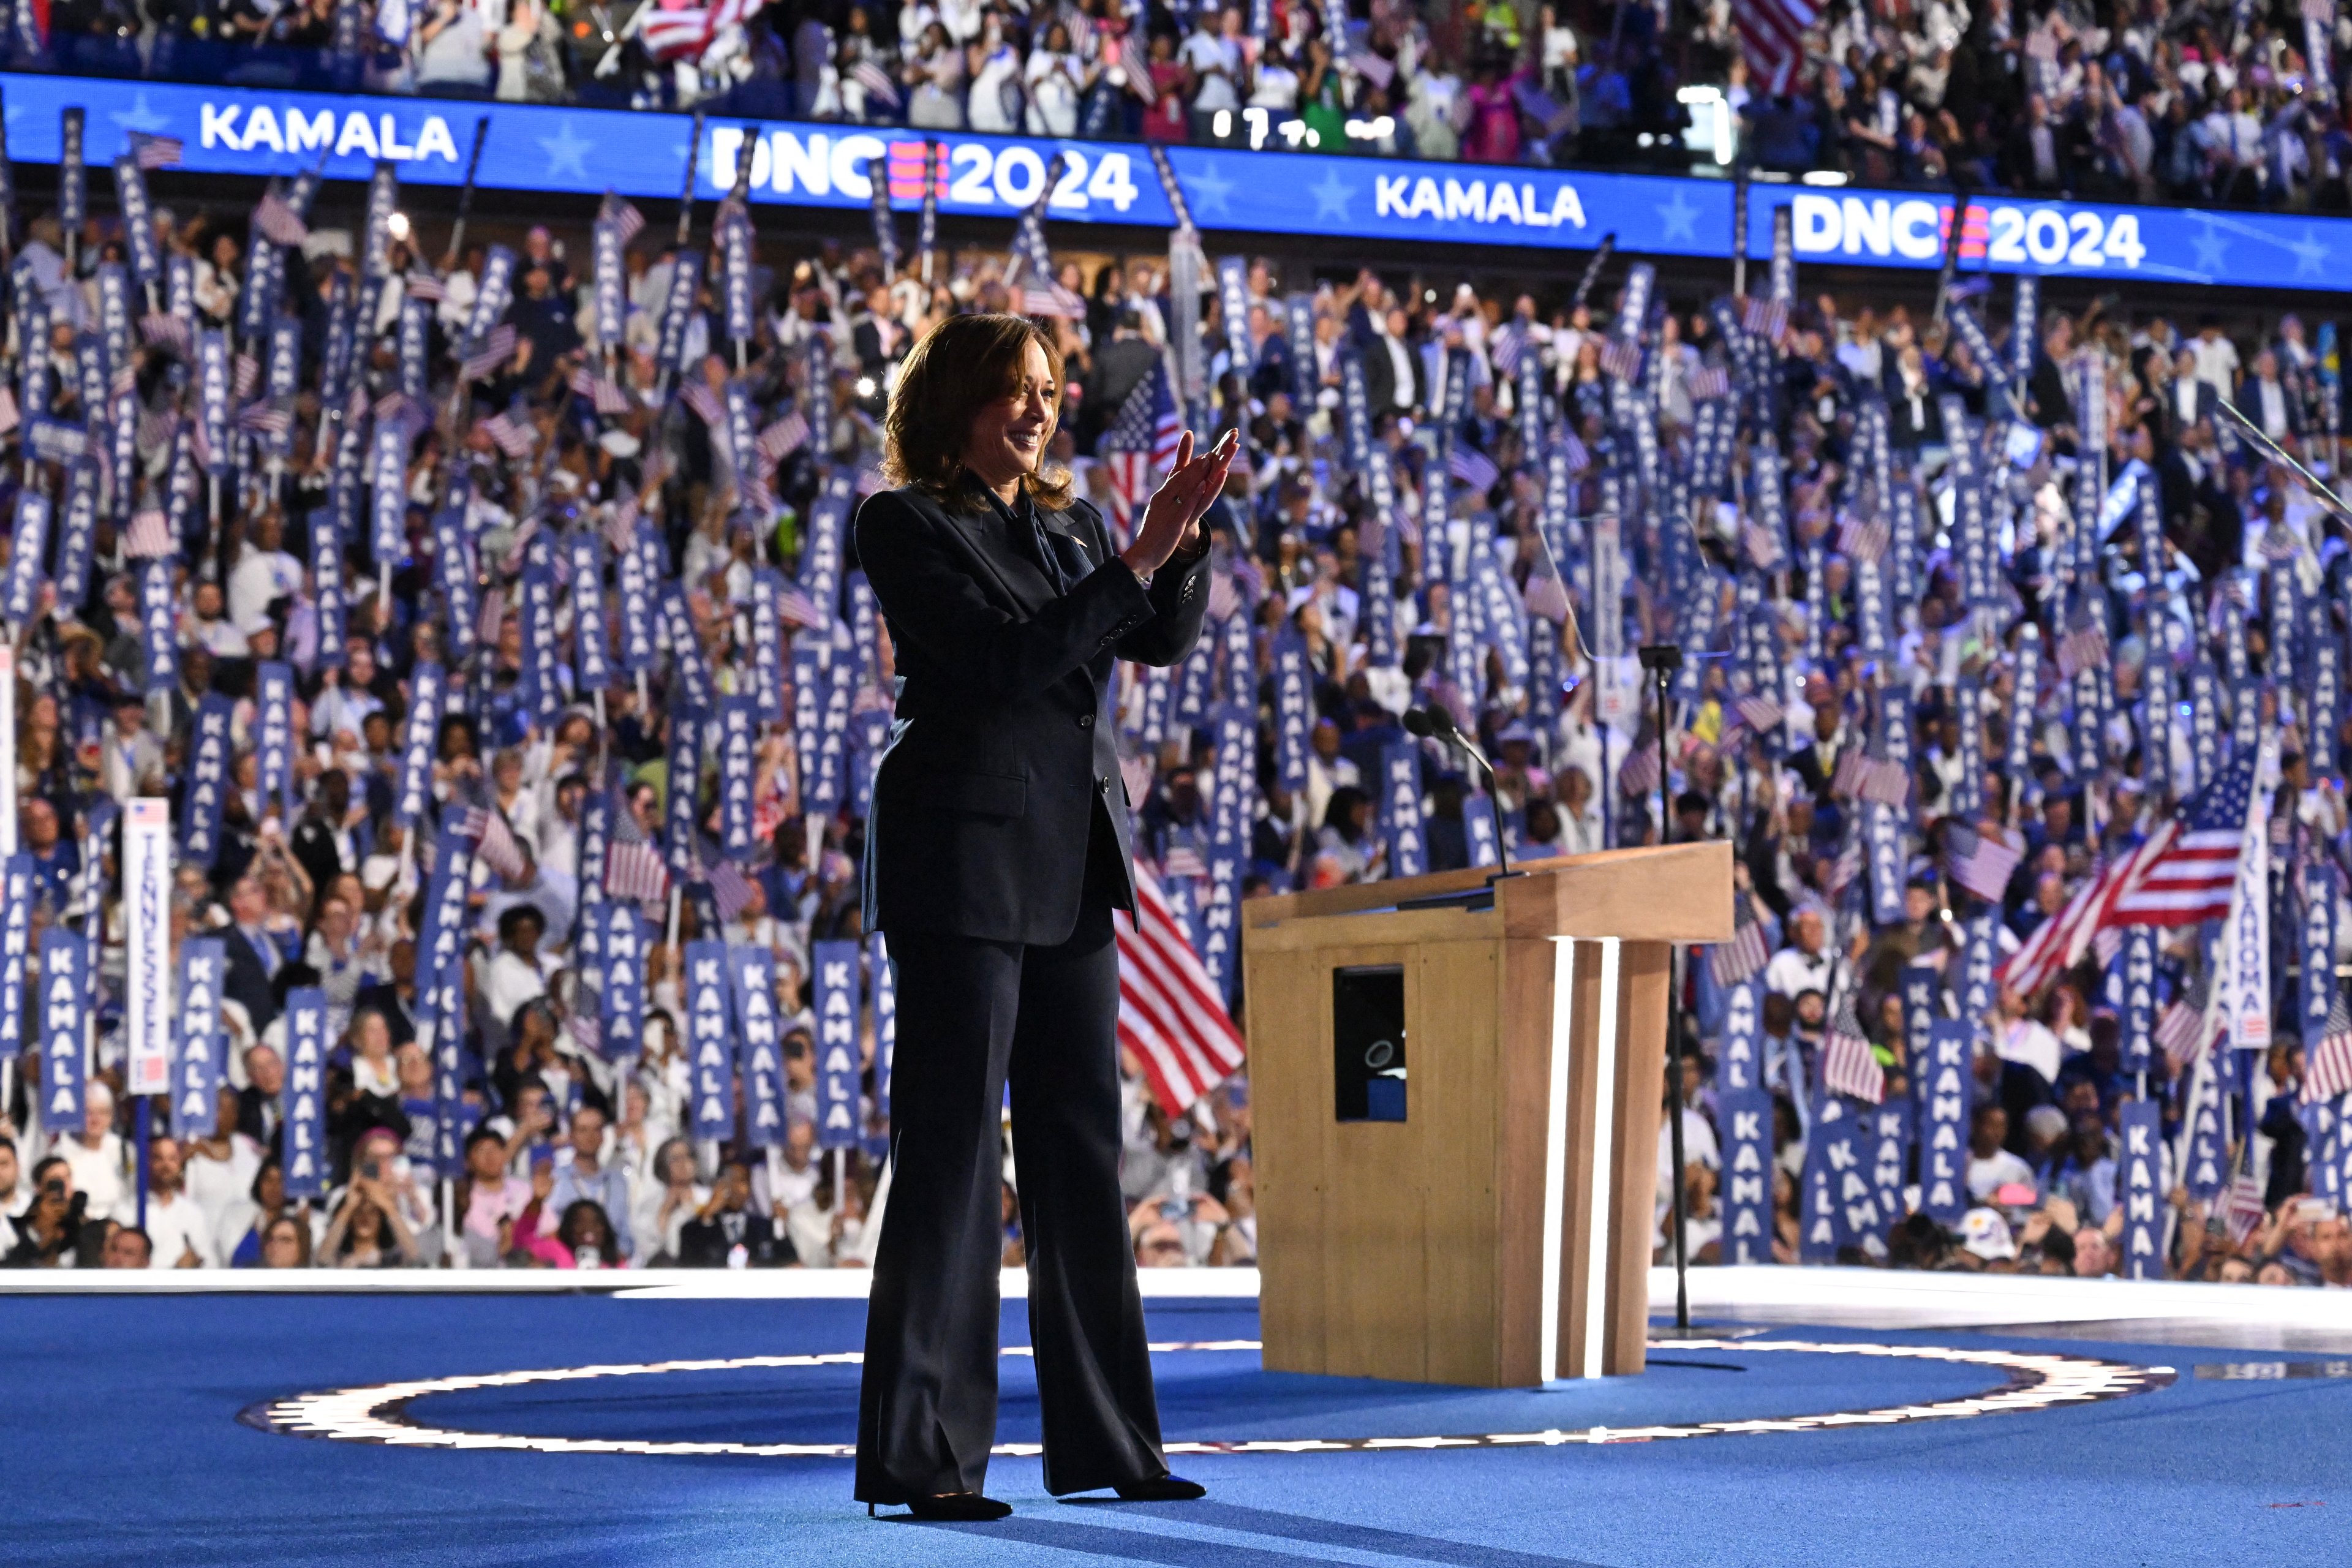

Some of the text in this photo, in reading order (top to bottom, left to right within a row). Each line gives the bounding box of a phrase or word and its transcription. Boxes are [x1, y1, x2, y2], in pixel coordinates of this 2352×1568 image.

[201, 103, 458, 162] KAMALA
[949, 143, 1138, 212] 2024
[1376, 175, 1586, 228] KAMALA
[1792, 194, 1938, 259] DNC
[1988, 206, 2145, 270] 2024
[146, 564, 172, 674] AMALA
[727, 710, 749, 846] KAMALA
[1392, 760, 1419, 876] KAMAL
[1205, 860, 1234, 979] KAMAL
[1873, 802, 1900, 908] AMALA
[48, 947, 77, 1113] KAMALA
[183, 957, 213, 1116] KAMALA
[608, 907, 636, 1038] AMALA
[1728, 985, 1754, 1087] AMAL
[292, 1009, 318, 1177] KAMALA
[695, 958, 724, 1121] KAMALA
[742, 963, 778, 1127] KAMALA
[823, 962, 853, 1128] KAMALA
[1930, 1039, 1961, 1205] KAMALA
[1731, 1112, 1763, 1264] KAMAL
